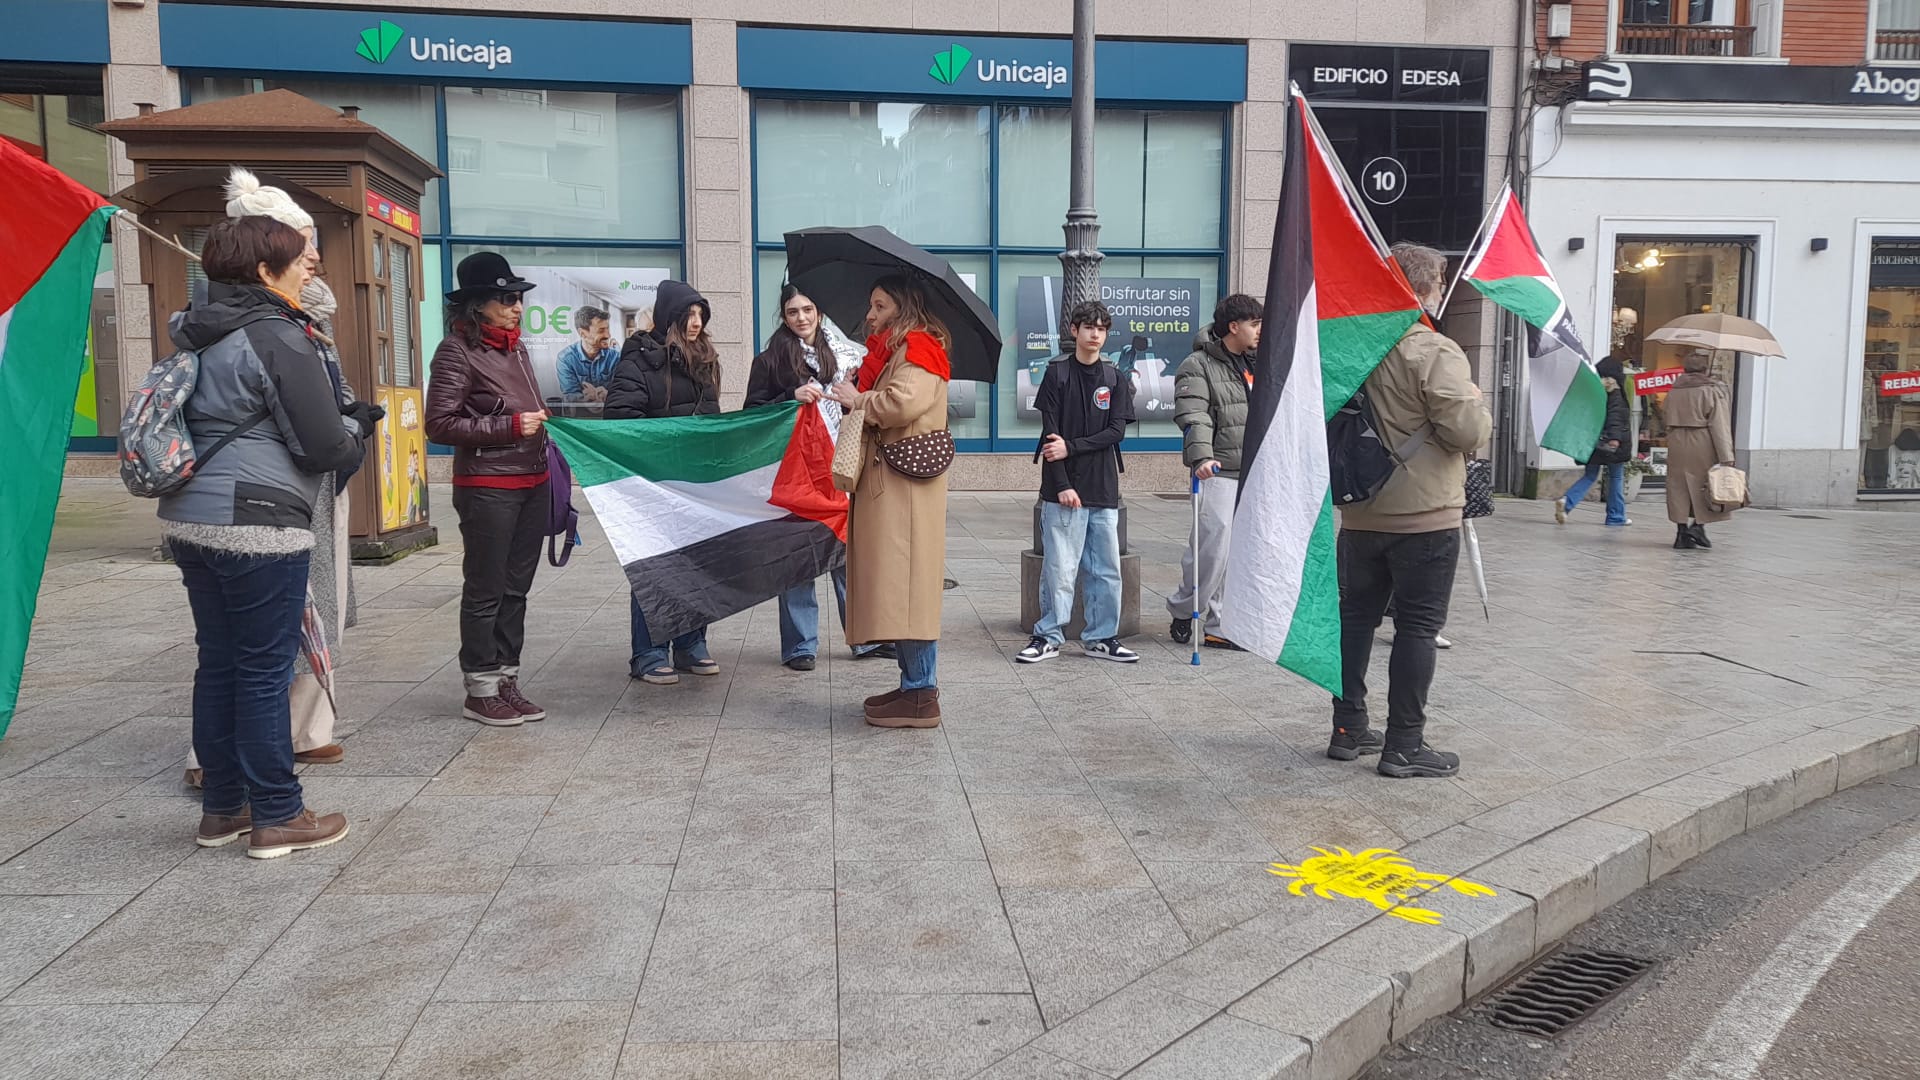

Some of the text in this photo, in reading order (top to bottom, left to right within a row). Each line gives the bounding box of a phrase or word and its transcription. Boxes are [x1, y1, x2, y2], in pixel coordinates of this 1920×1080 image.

[410, 37, 512, 70] Unicaja
[977, 59, 1067, 89] Unicaja
[1314, 67, 1461, 86] EDIFICIO EDESA
[1850, 71, 1920, 102] Abog
[1372, 171, 1396, 191] 10
[631, 282, 658, 293] Unicaja
[1101, 286, 1190, 300] Disfrutar sin
[1107, 302, 1190, 317] comisiones
[523, 305, 573, 335] 0€
[1129, 319, 1189, 333] te renta
[1638, 373, 1682, 390] REBAJ
